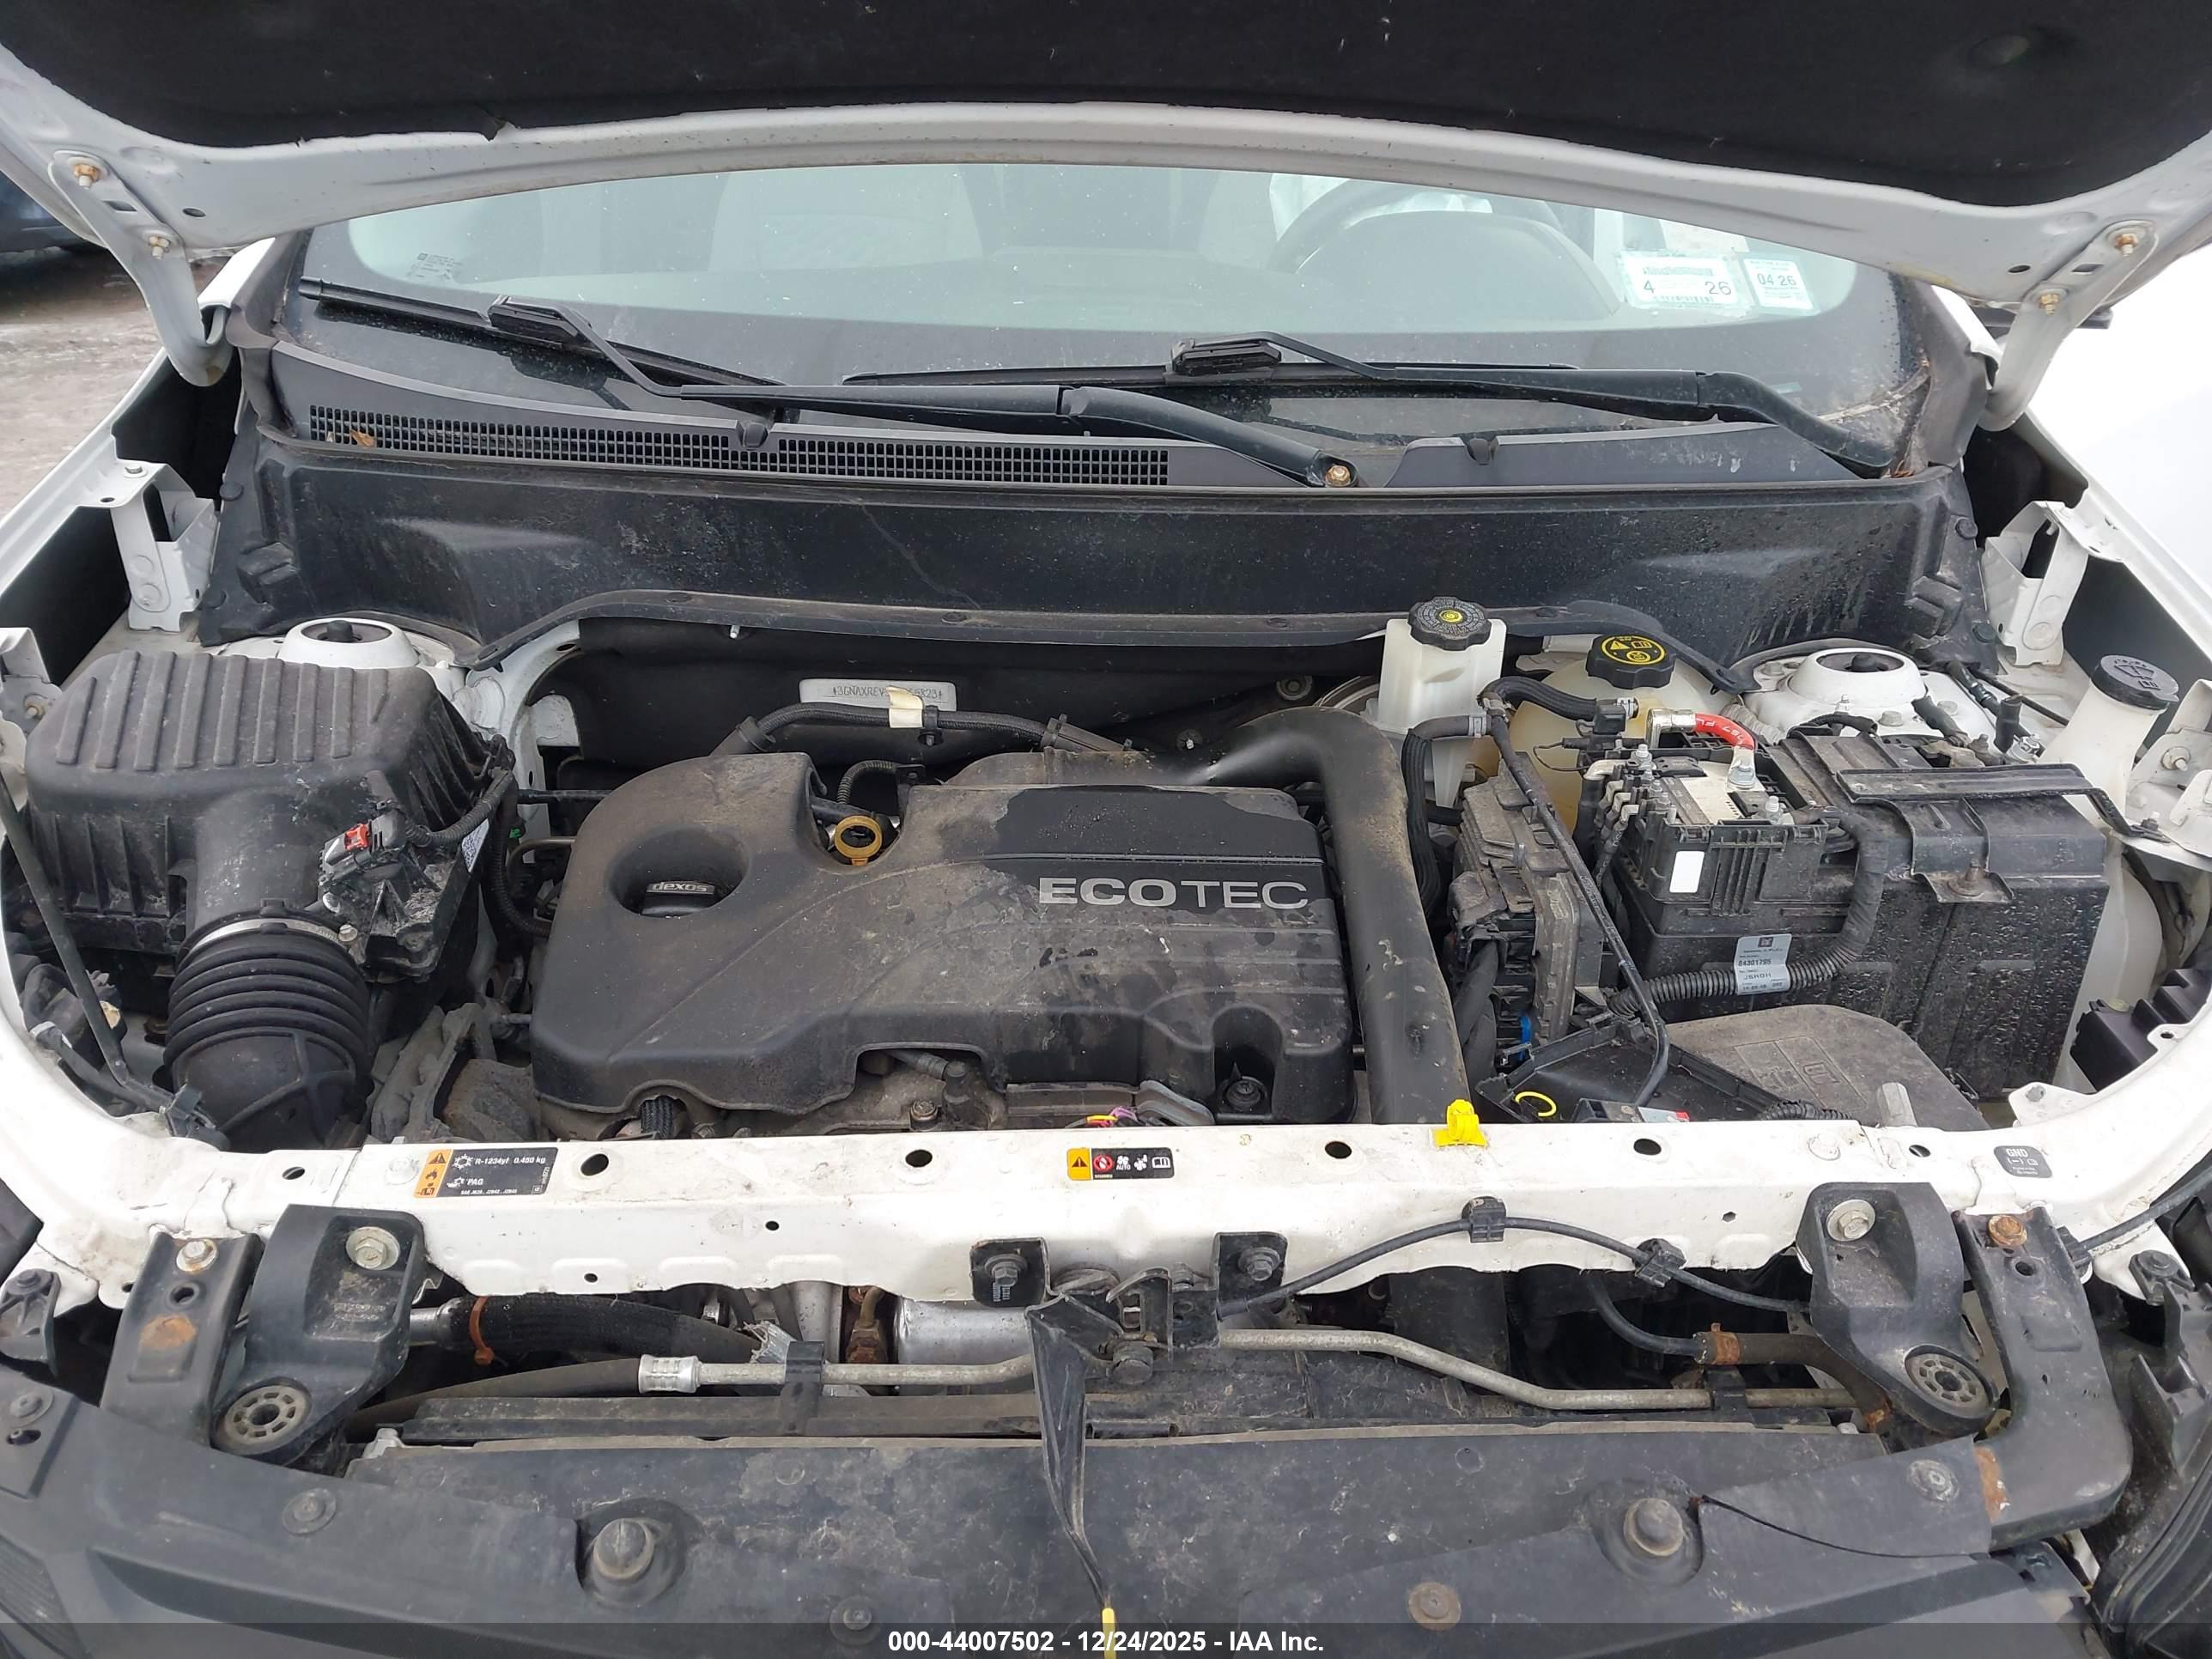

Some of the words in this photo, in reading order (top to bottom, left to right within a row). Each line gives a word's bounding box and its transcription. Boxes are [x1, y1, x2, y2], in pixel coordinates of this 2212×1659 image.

[1756, 272, 1774, 286] 04
[1778, 274, 1797, 287] 26
[1644, 279, 1656, 294] 4
[1705, 280, 1732, 295] 26
[652, 881, 708, 892] dexos
[1038, 876, 1310, 910] ECOTEC
[2006, 1148, 2028, 1157] GND
[536, 1156, 546, 1165] kg
[466, 1178, 484, 1187] PAG
